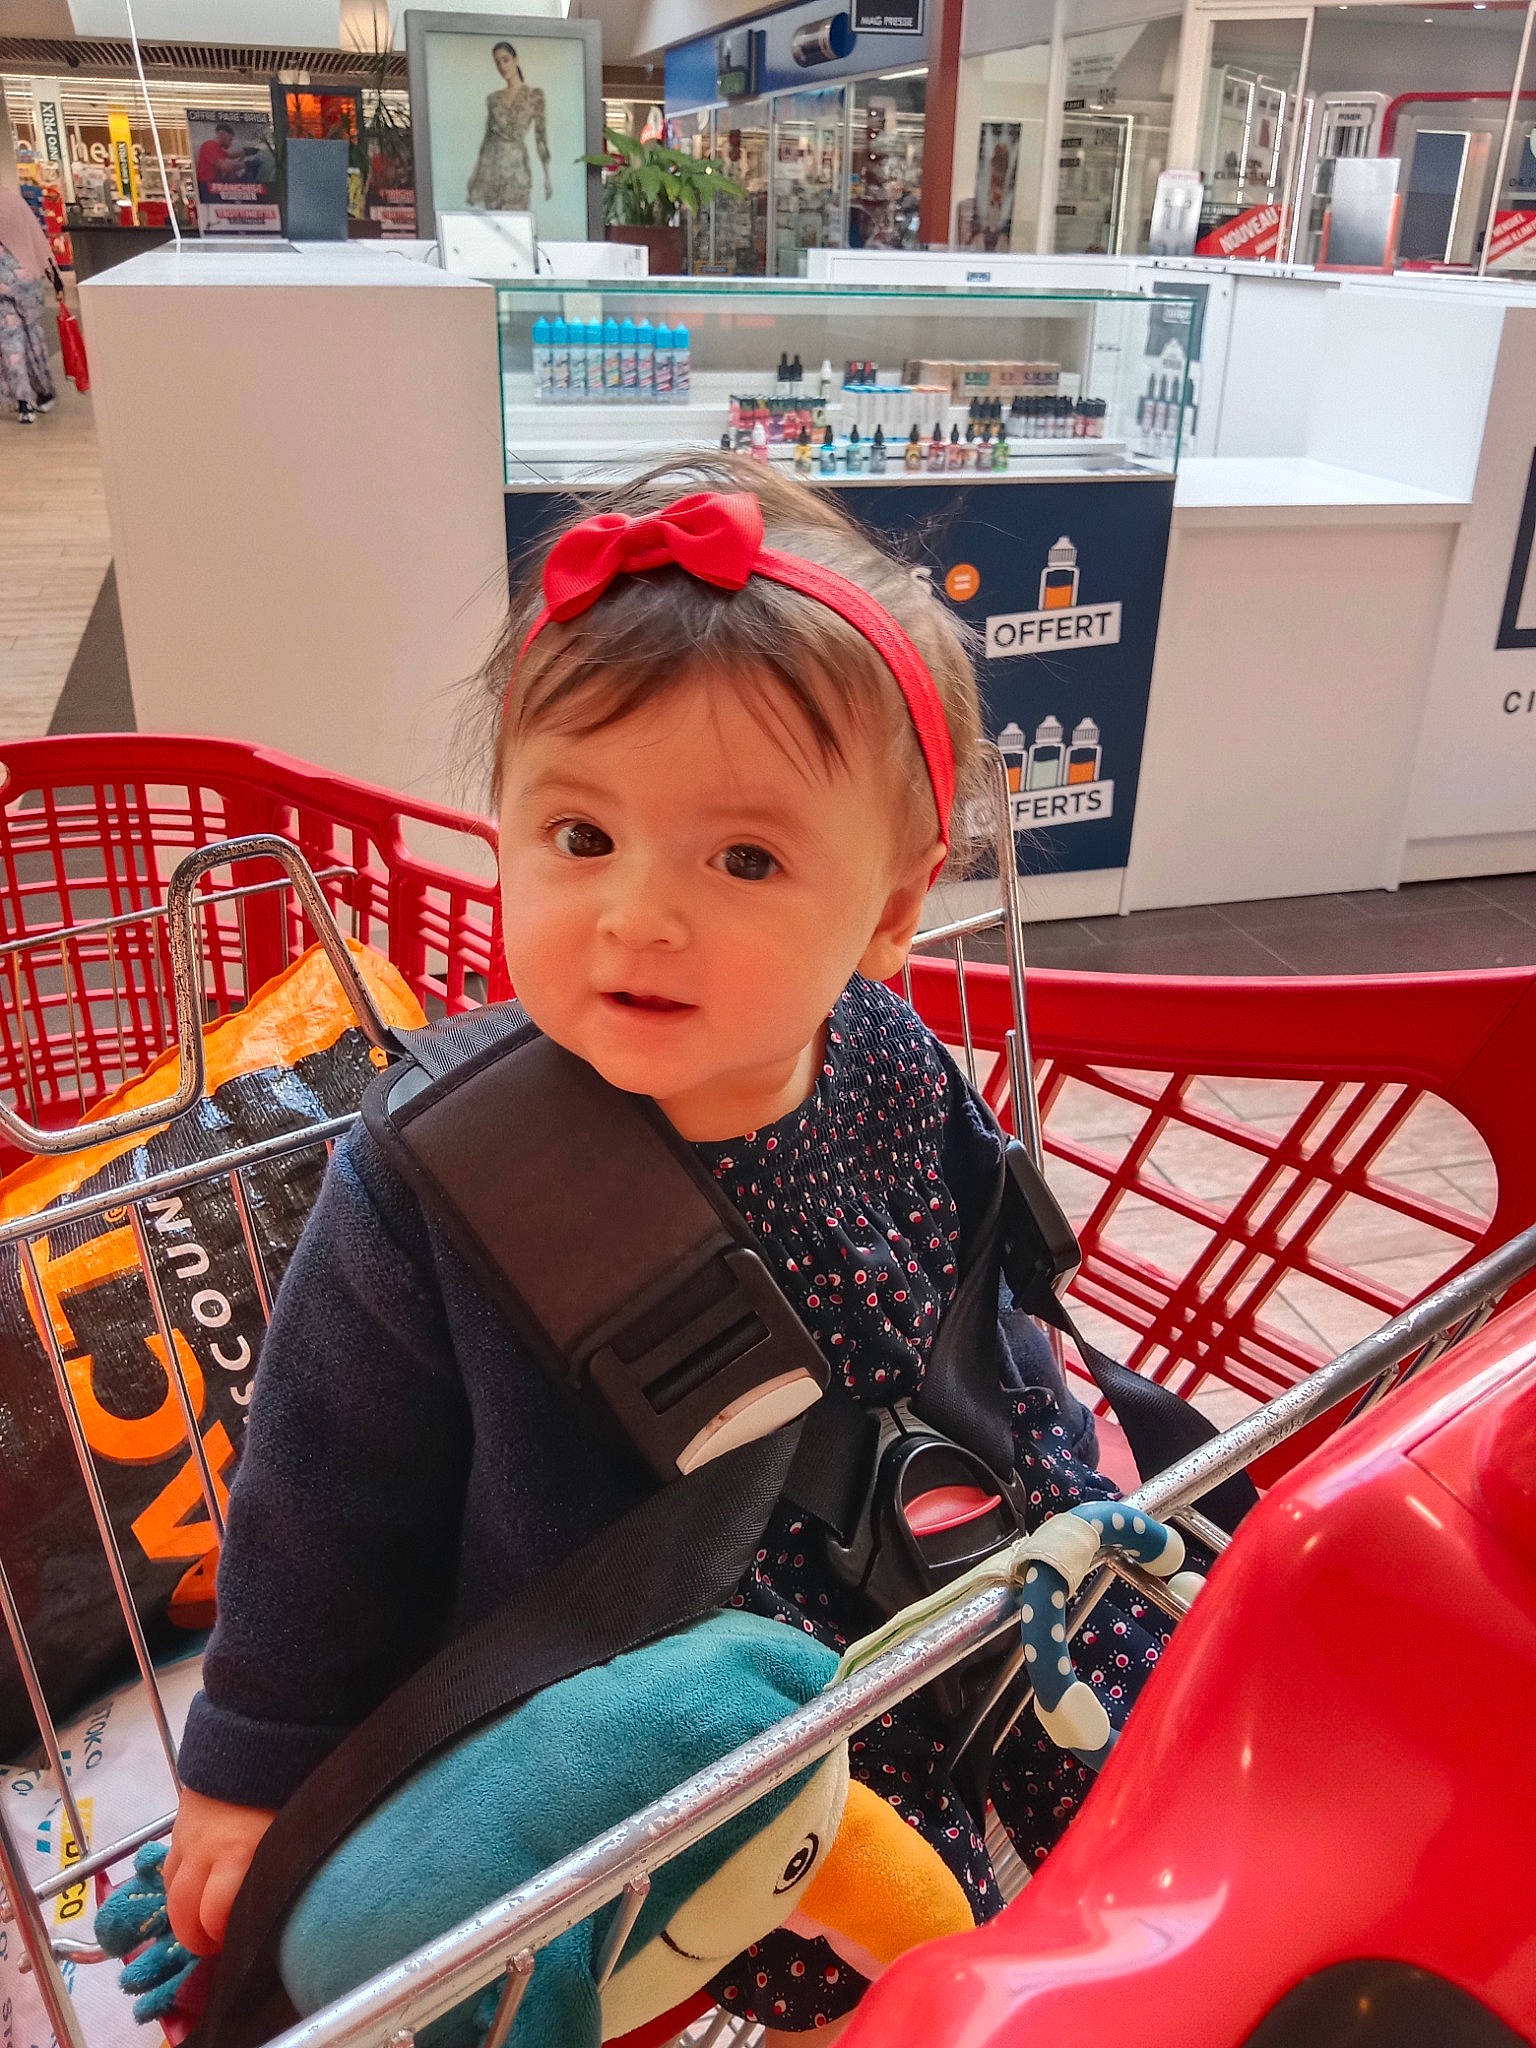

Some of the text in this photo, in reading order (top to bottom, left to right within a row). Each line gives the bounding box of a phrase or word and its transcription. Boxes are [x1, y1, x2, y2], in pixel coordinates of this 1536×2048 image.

[42, 103, 59, 161] INFO PRIX
[1219, 206, 1280, 254] NOUVEAU
[994, 611, 1112, 648] OFFERT
[21, 1226, 236, 1629] ACT
[84, 1702, 113, 1770] TOKO
